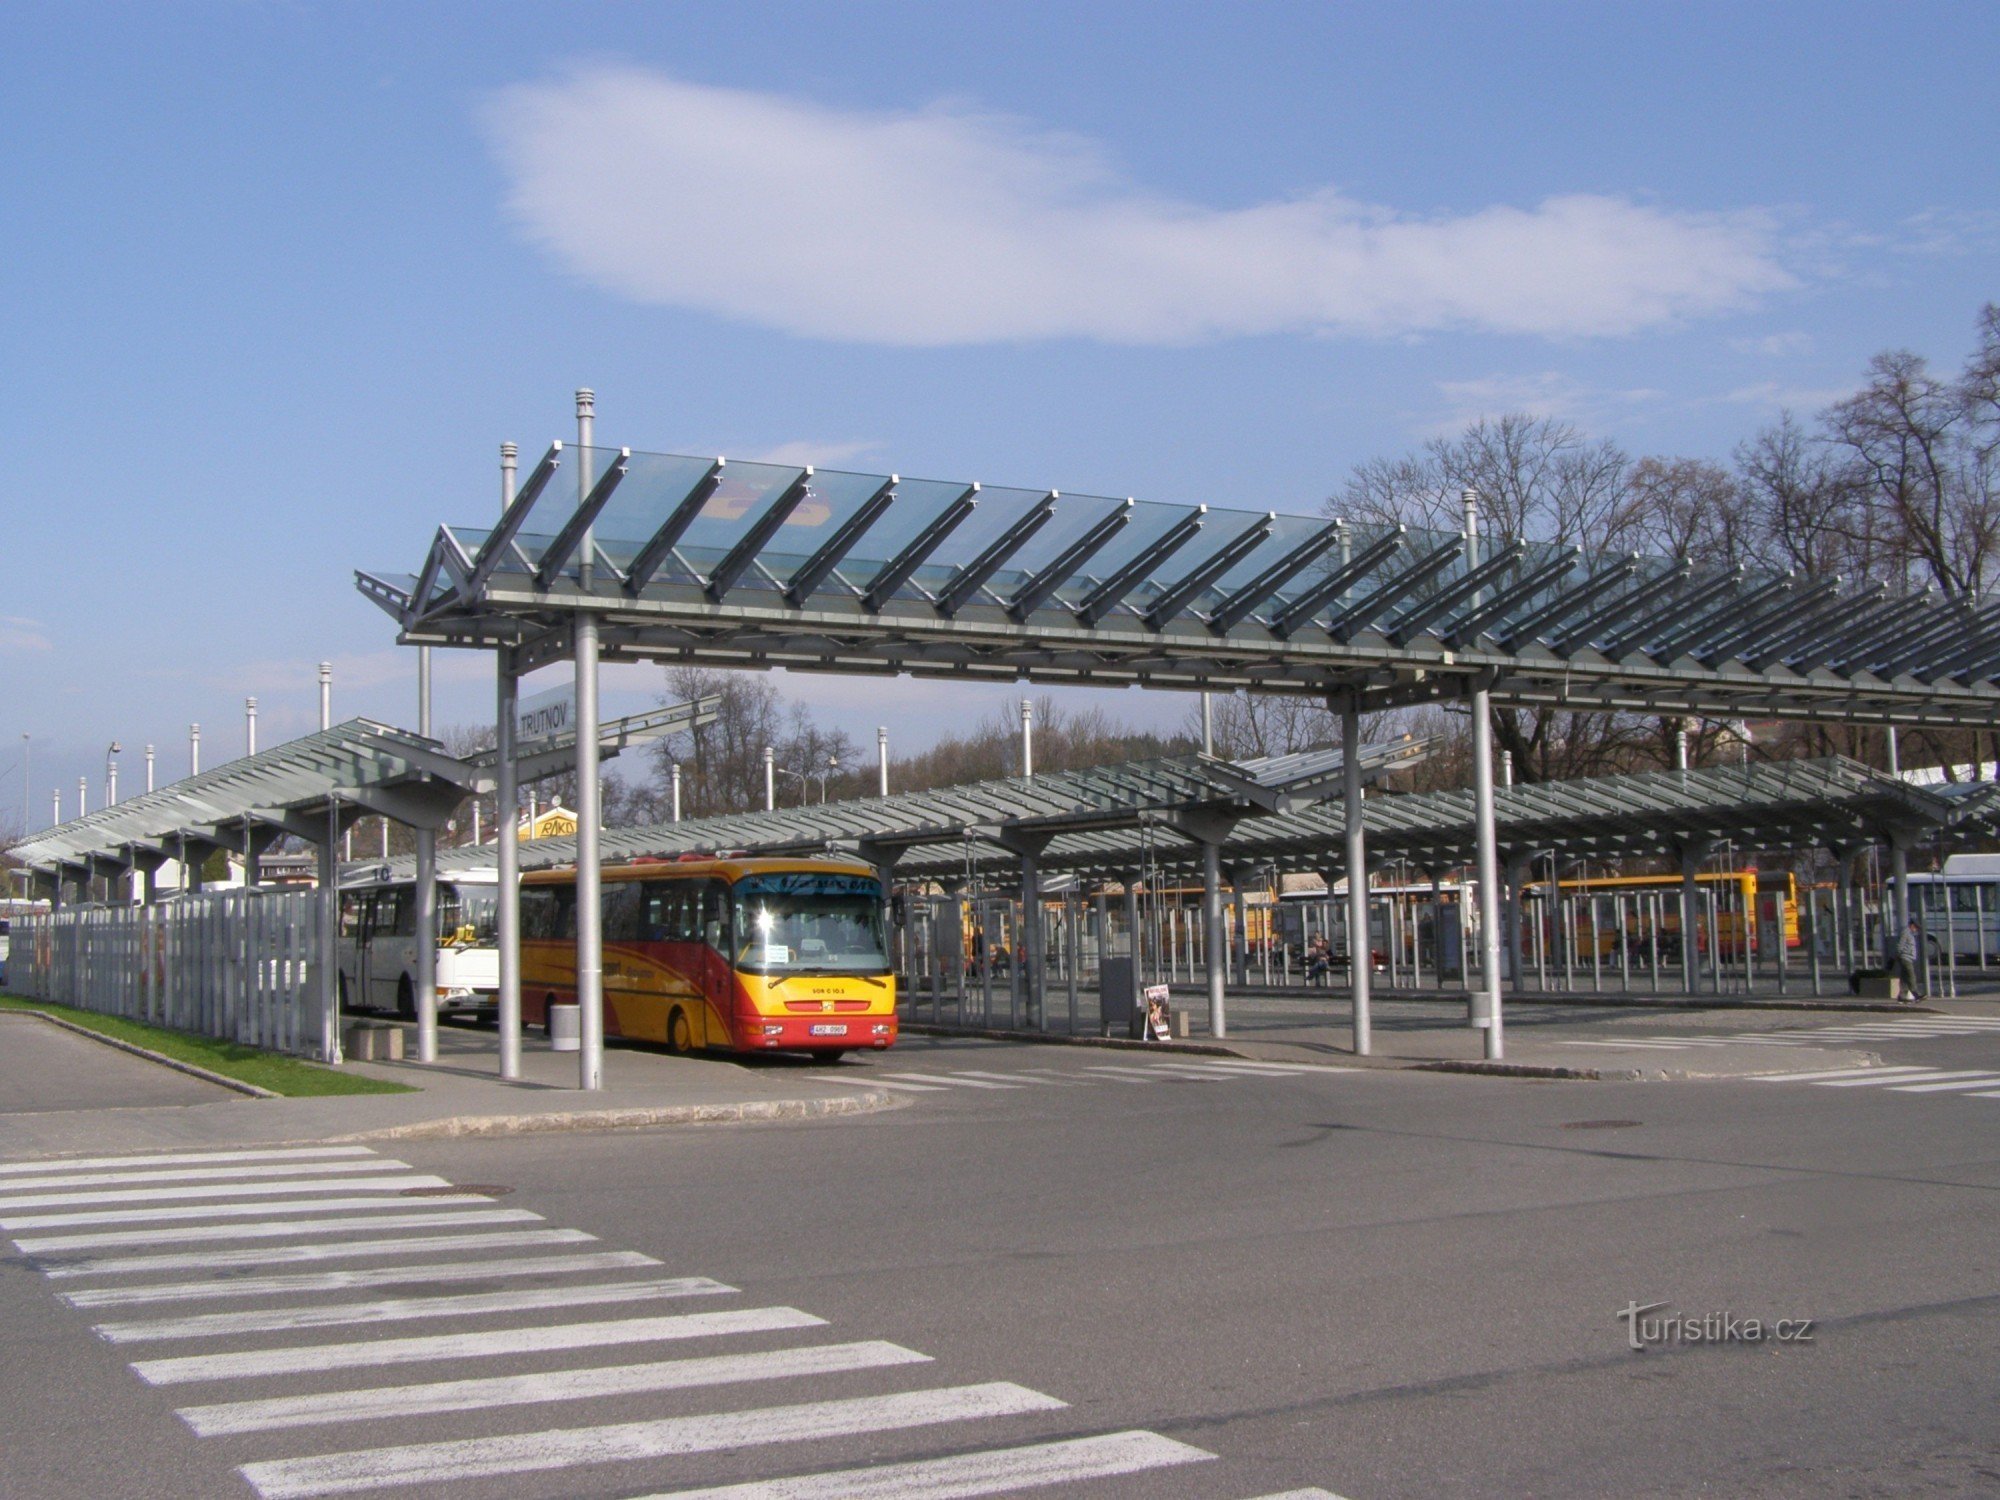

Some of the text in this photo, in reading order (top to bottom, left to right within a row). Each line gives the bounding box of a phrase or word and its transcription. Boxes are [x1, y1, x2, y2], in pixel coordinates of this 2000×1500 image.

[521, 702, 567, 737] TRUTNOV
[541, 820, 575, 836] RAKO
[371, 867, 390, 882] 10
